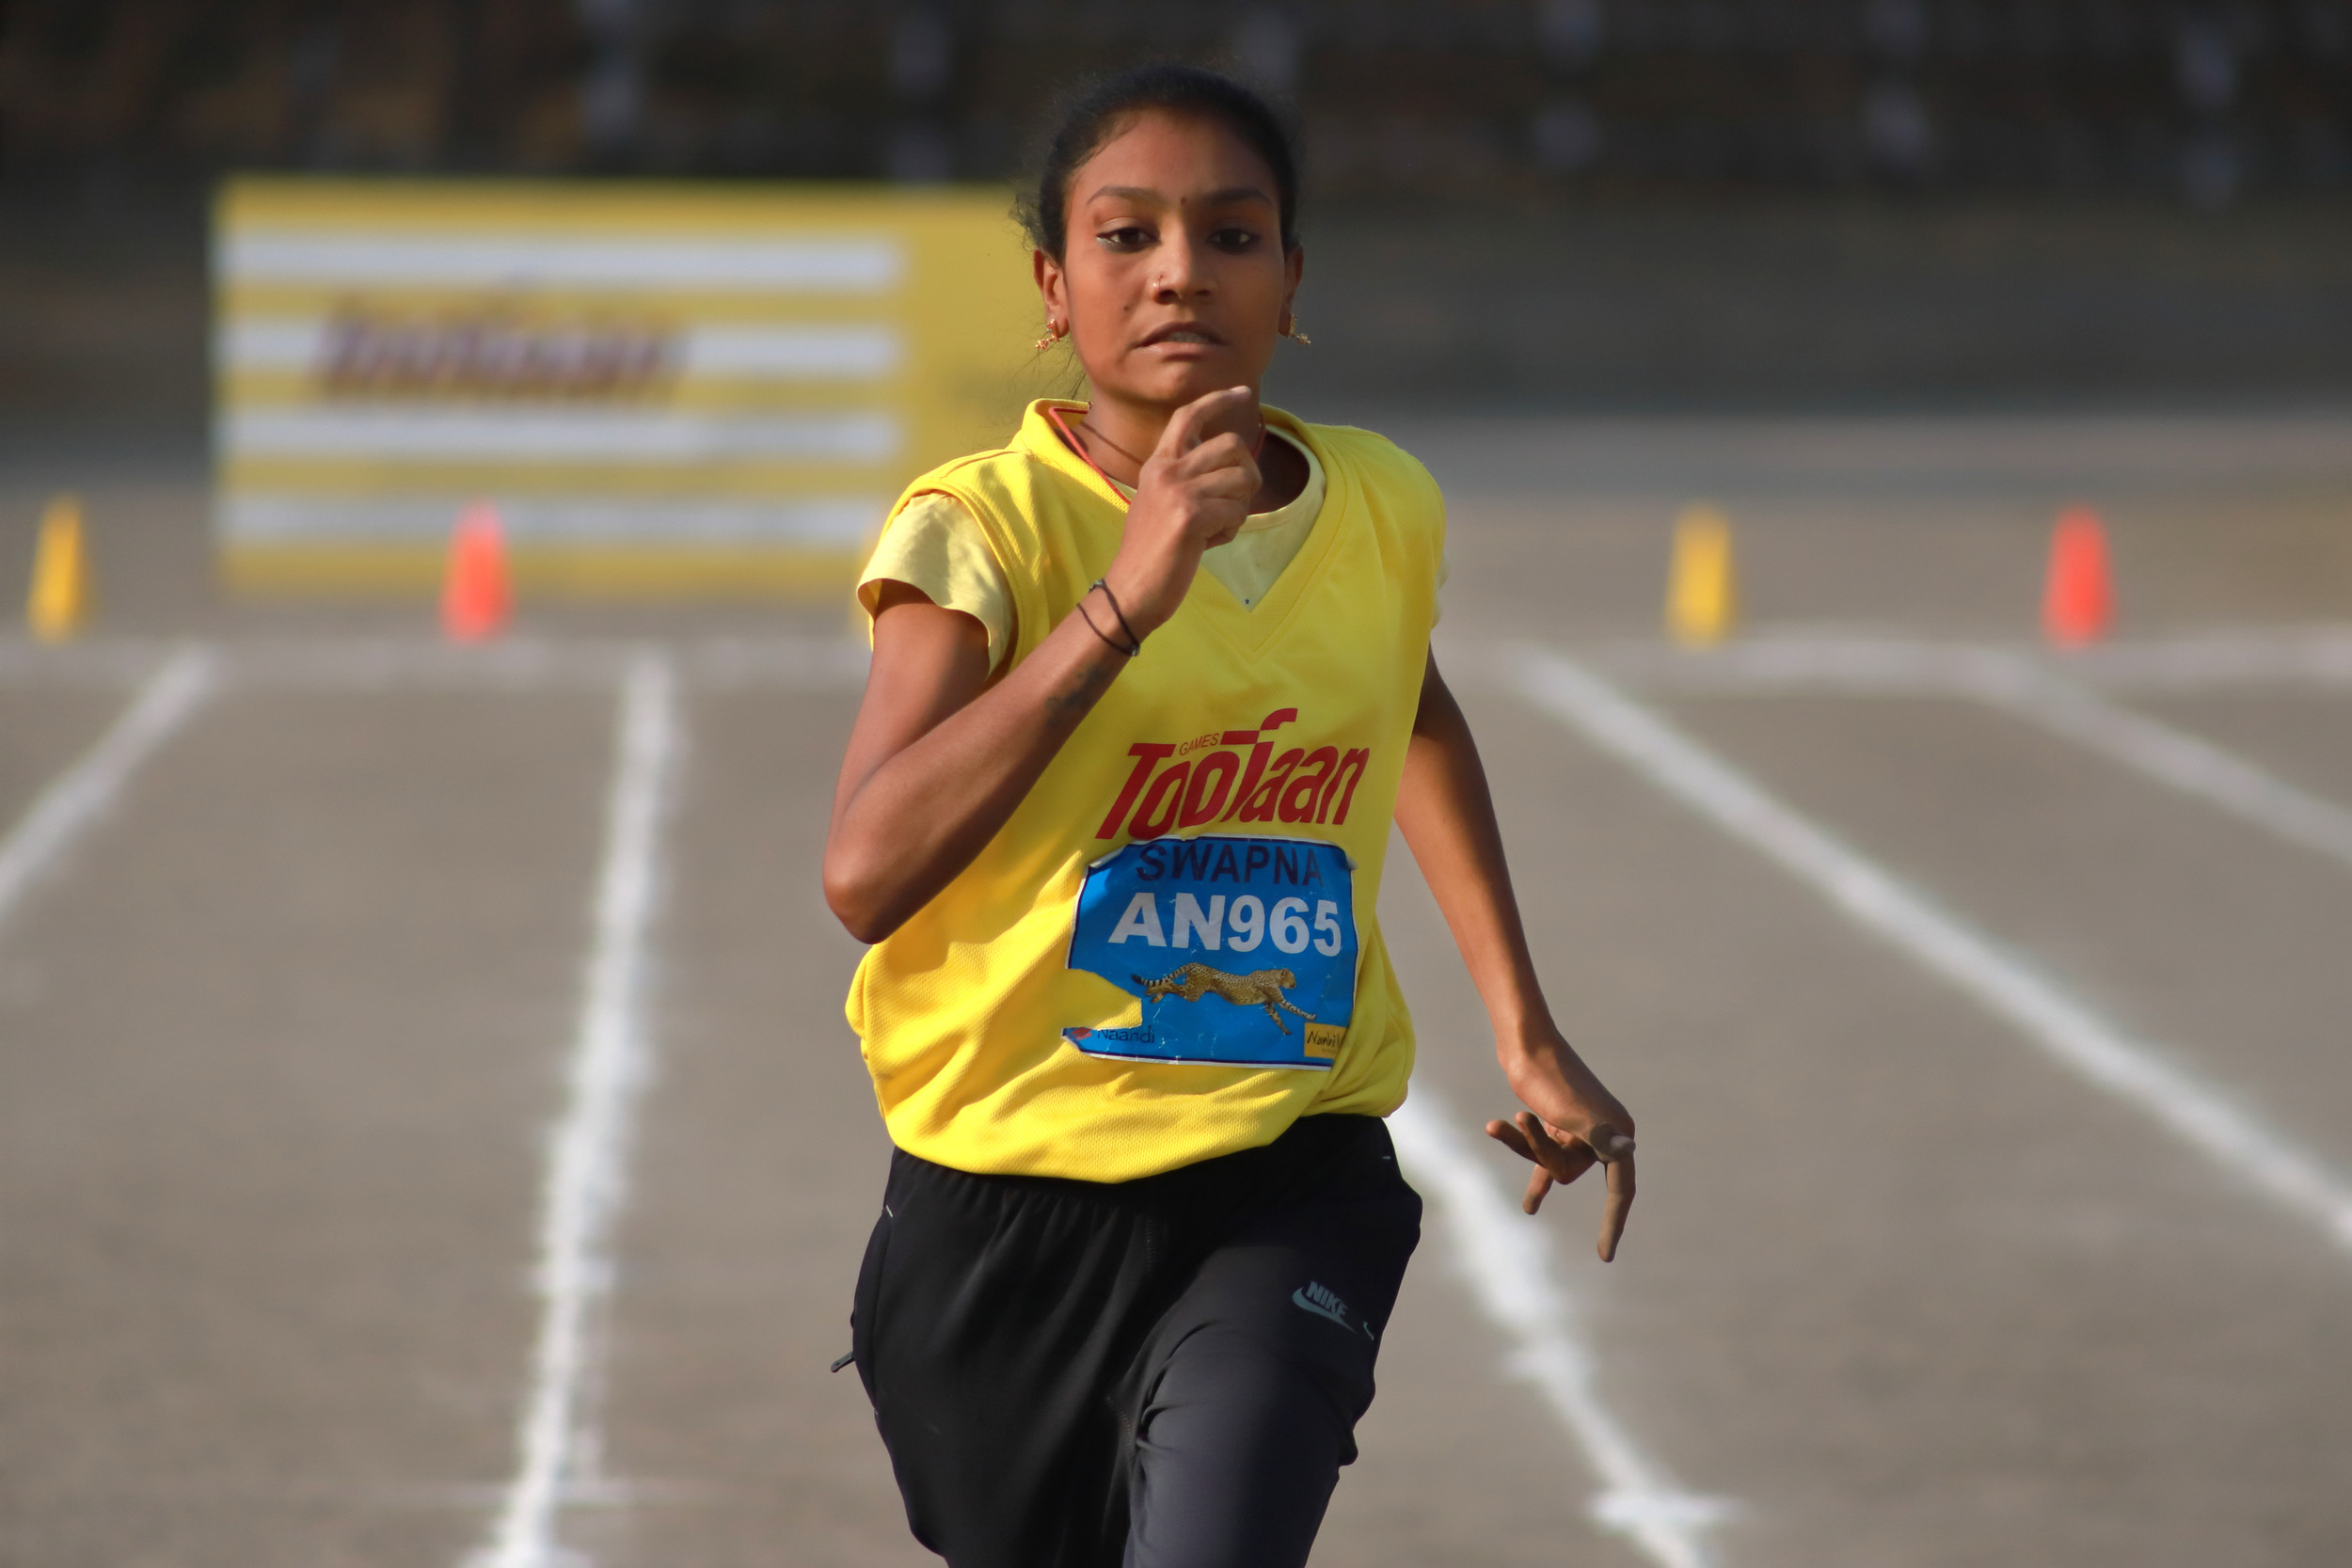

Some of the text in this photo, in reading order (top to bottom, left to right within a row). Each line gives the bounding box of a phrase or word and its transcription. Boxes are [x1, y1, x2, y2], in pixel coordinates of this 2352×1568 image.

[1179, 732, 1220, 756] GAMES
[1095, 708, 1370, 839] Toofaan
[1136, 844, 1324, 886] SWAPNA
[1108, 892, 1342, 957] AN965
[1097, 1024, 1155, 1043] Naandi
[1306, 1280, 1348, 1317] NIKE
